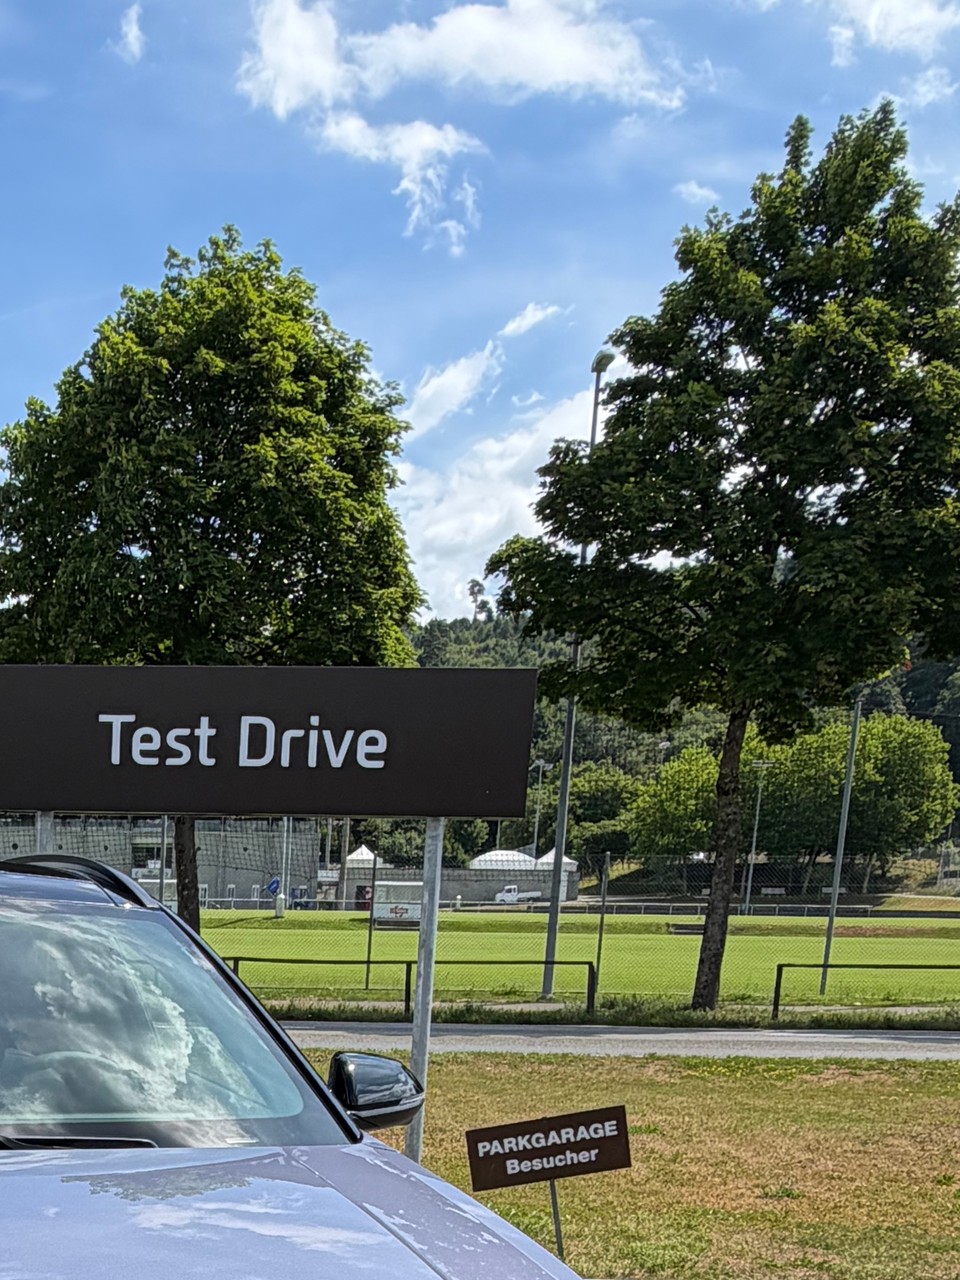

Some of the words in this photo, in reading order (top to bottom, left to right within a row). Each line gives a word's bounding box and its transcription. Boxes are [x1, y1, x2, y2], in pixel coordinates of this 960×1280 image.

[98, 714, 217, 766] Test
[238, 715, 388, 769] Drive
[477, 1120, 618, 1157] PARKGARAGE
[506, 1148, 599, 1175] Besucher
